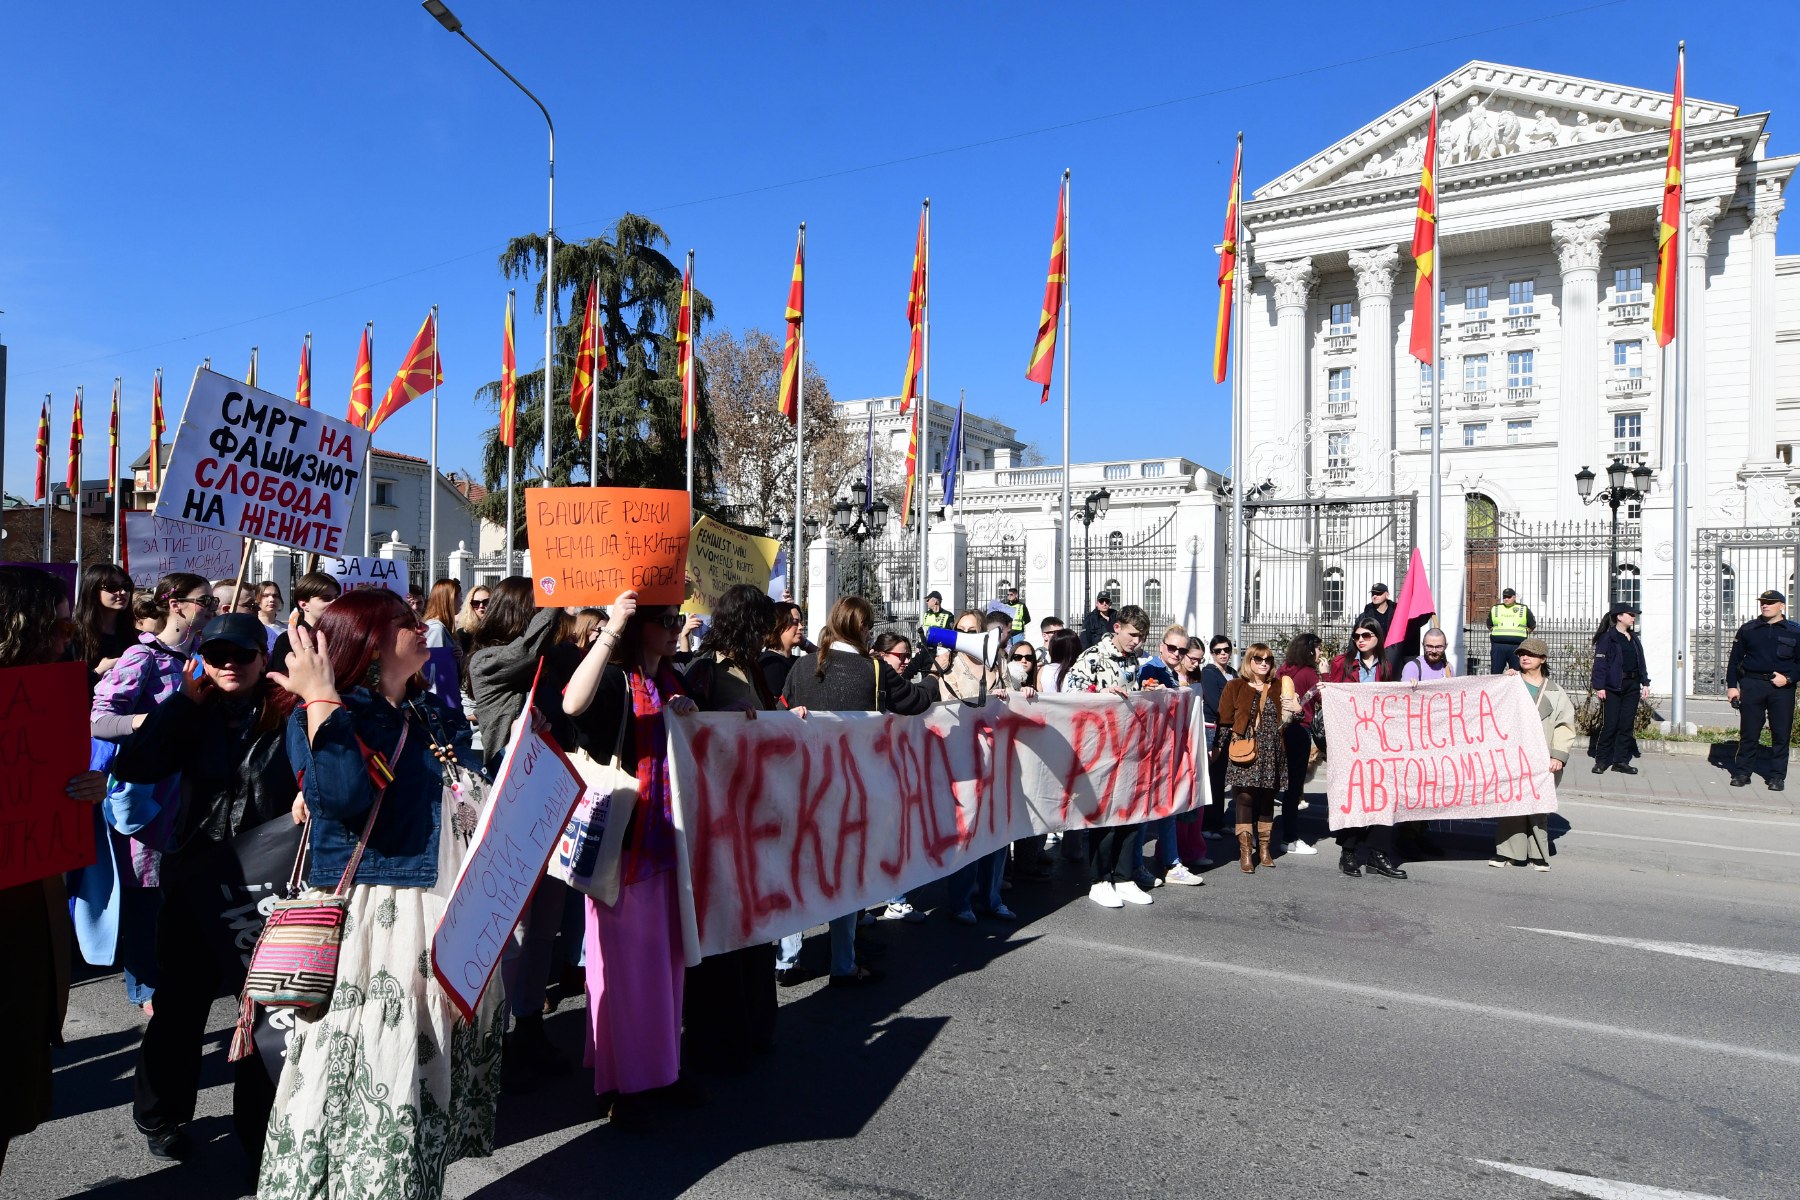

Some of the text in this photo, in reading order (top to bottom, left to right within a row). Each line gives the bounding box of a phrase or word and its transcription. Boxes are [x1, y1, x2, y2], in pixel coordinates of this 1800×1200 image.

[221, 391, 353, 463] СМРТ НА
[195, 457, 332, 519] СЛОБОДА
[209, 426, 358, 495] ФАШИЗМОТ
[182, 488, 225, 526] НА
[238, 502, 342, 553] ЖЕНИТЕ
[537, 500, 613, 526] ВАШИТЕ
[143, 535, 223, 554] ЗА ТИЕ ШТО
[158, 556, 178, 571] НЕ
[336, 558, 398, 580] ЗА ДА
[546, 534, 596, 560] НЕМА
[599, 534, 622, 557] ДА
[643, 530, 687, 557] КИТАТ
[563, 558, 681, 592] НАШАТА БОРБА!
[1349, 690, 1508, 753] ЖЕНСКА
[1340, 745, 1540, 814] АВТОНОМИЈА
[692, 726, 868, 941] НЕКА
